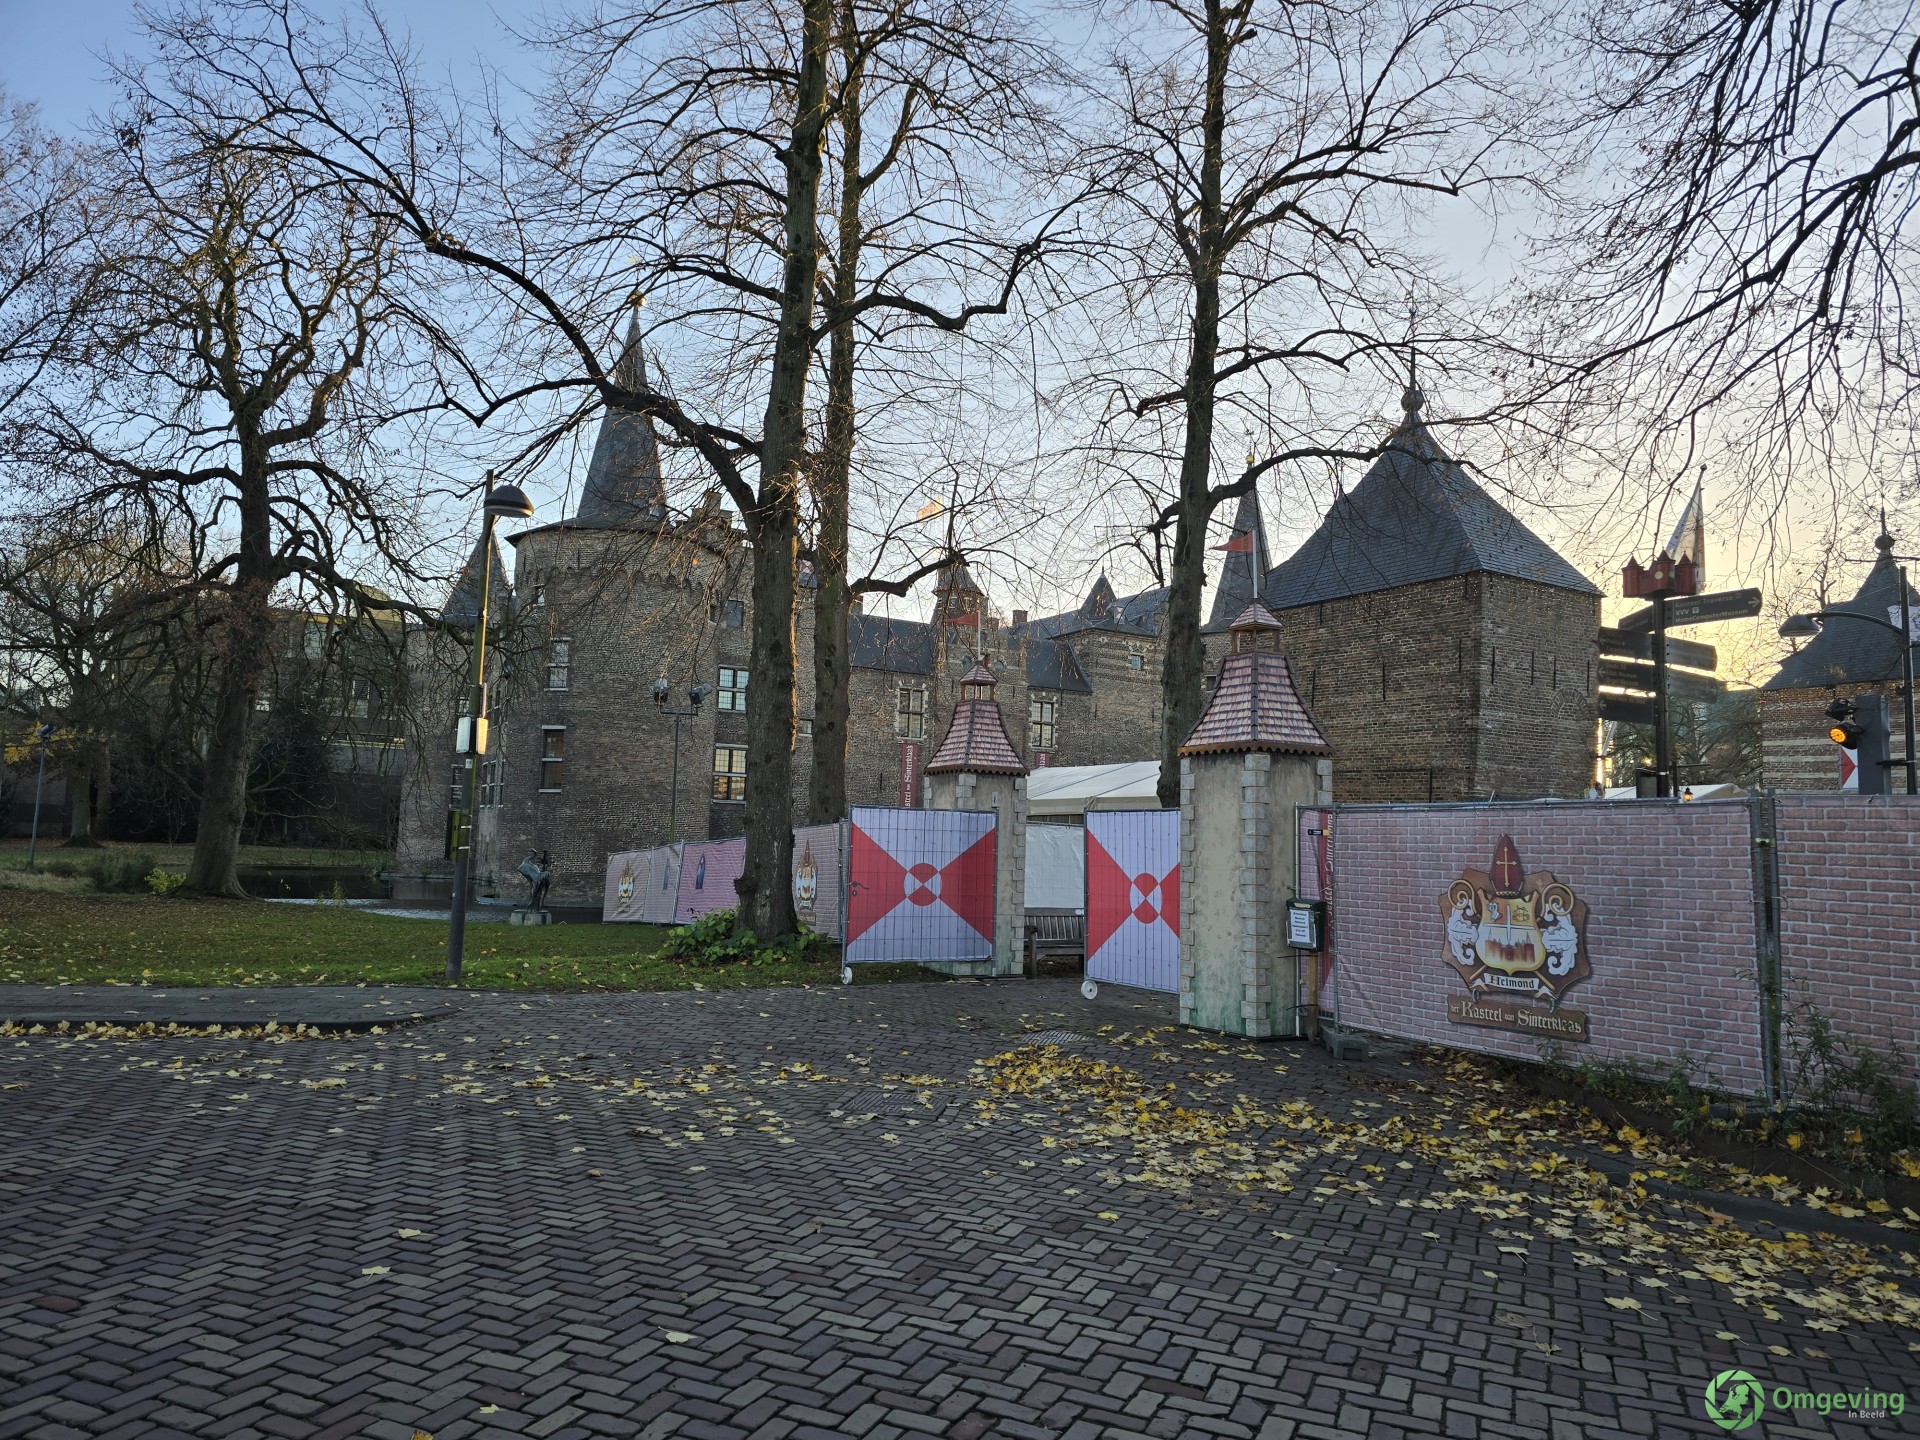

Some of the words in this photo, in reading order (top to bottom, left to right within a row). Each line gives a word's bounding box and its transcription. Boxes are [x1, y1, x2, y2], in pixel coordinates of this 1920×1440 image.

[1703, 596, 1734, 604] Traverse
[1675, 608, 1690, 616] VVV
[1675, 609, 1749, 623] HomeComputerMuseum
[1489, 975, 1535, 989] Helmond
[1460, 1000, 1503, 1022] Kasteel
[1516, 1008, 1582, 1034] Sinterklaas
